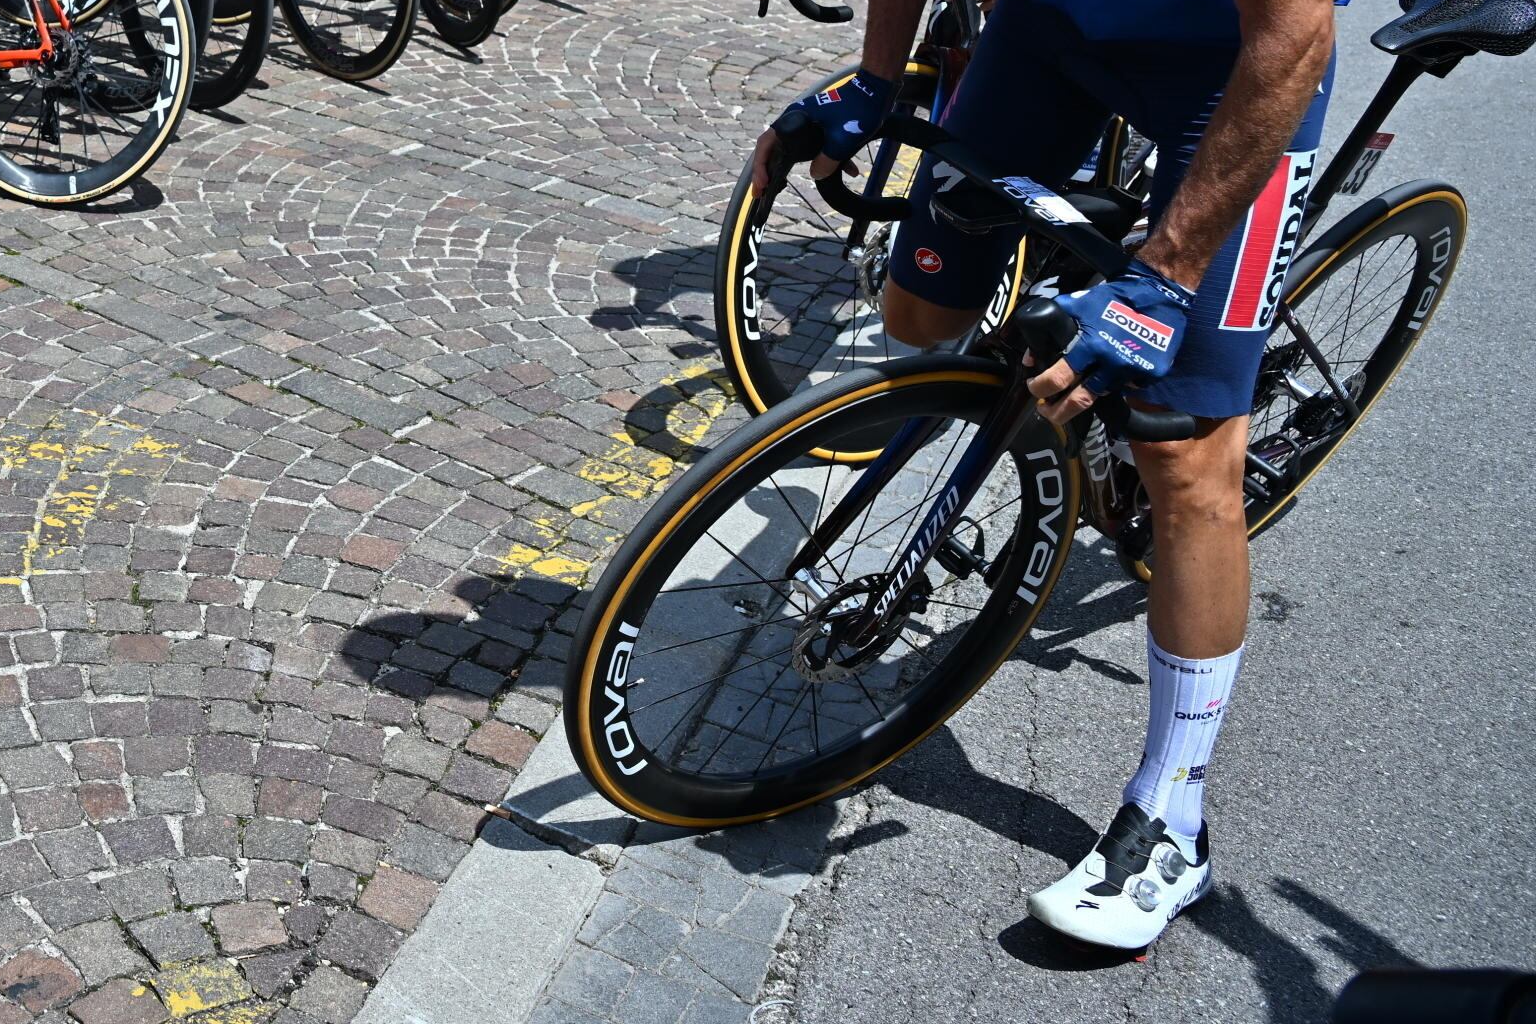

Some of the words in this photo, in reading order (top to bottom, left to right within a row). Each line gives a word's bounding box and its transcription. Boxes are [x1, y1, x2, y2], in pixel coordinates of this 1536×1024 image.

[1337, 148, 1383, 195] 33
[742, 225, 766, 342] rova
[1257, 151, 1317, 328] SOUDAL
[1407, 225, 1452, 331] roval
[1098, 329, 1156, 372] QUICK-STEP
[1104, 308, 1168, 349] SOUDAL
[872, 484, 961, 618] SPECIALIZED
[1016, 448, 1064, 606] roval
[603, 621, 648, 777] roval
[1174, 707, 1226, 722] QUICK-S
